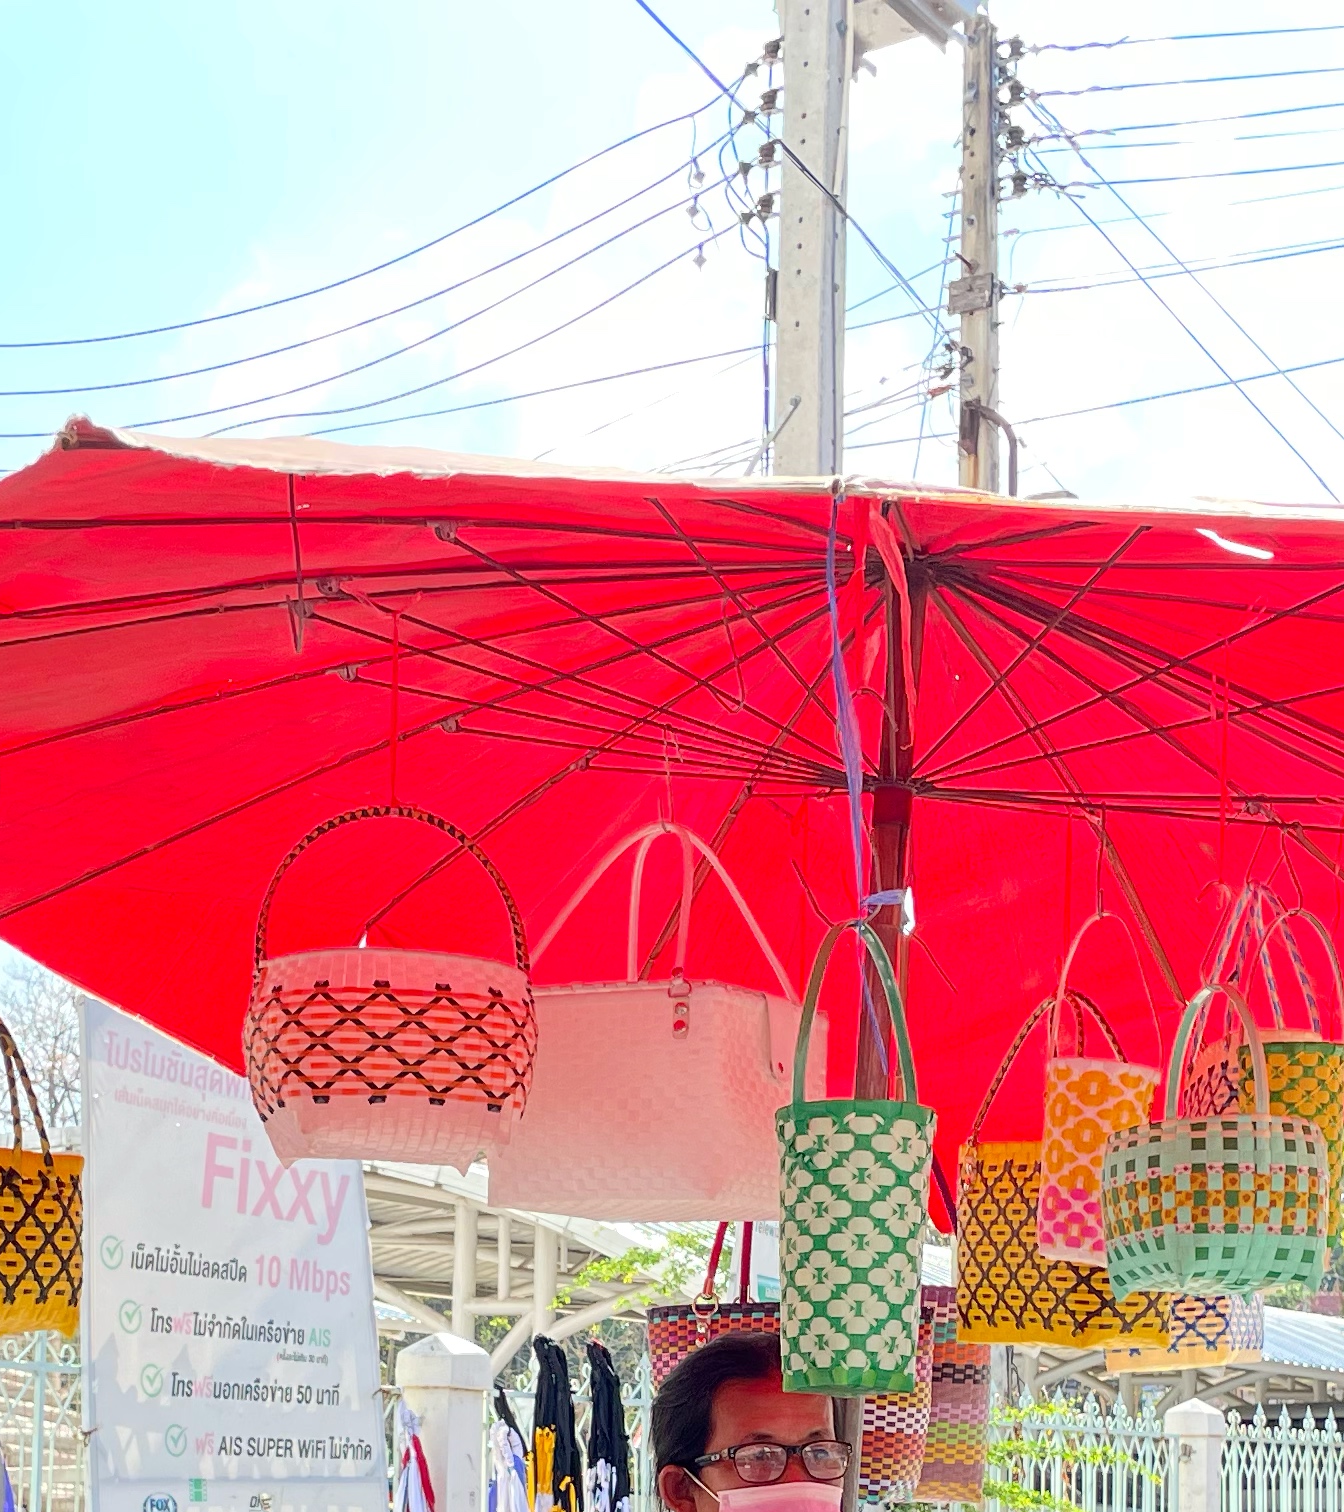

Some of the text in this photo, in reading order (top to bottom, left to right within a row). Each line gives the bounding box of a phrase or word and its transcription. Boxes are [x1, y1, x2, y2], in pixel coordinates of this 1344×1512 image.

[201, 1132, 350, 1245] Fixxy
[255, 1253, 282, 1288] 10
[289, 1258, 351, 1302] Mbps
[308, 1328, 332, 1348] AIS
[296, 1385, 313, 1405] 50
[316, 1383, 341, 1406] นาที
[195, 1432, 373, 1460] ฟรี AIS SUPER WiFi ไม่จำกัด
[150, 1498, 170, 1511] FOX
